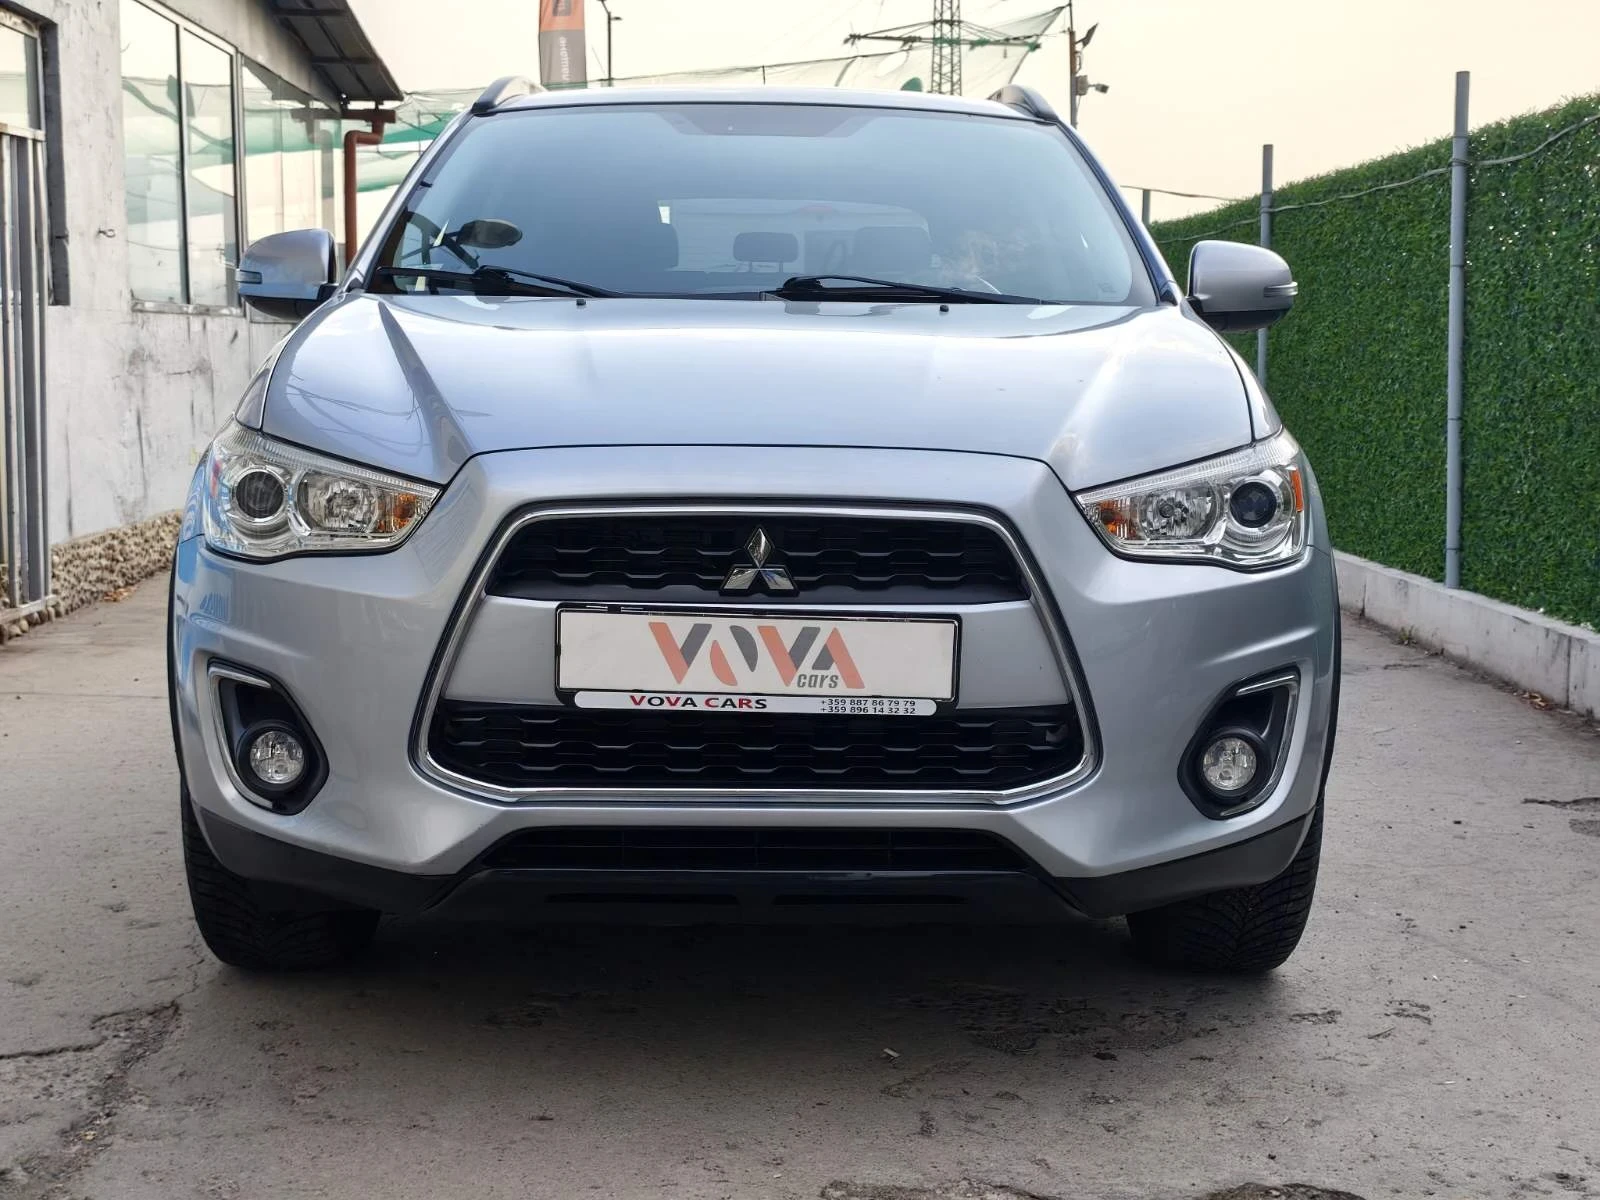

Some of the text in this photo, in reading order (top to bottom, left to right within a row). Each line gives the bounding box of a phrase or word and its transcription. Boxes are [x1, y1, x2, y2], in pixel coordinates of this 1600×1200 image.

[648, 621, 866, 689] VOVA
[796, 673, 839, 689] cars
[629, 695, 768, 709] VOVA CARS
[821, 698, 847, 706] +359
[871, 699, 885, 707] 86
[887, 699, 900, 707] 79
[820, 705, 847, 713] +359
[849, 706, 869, 714] 896
[872, 706, 885, 714] 14
[903, 707, 916, 715] 32
